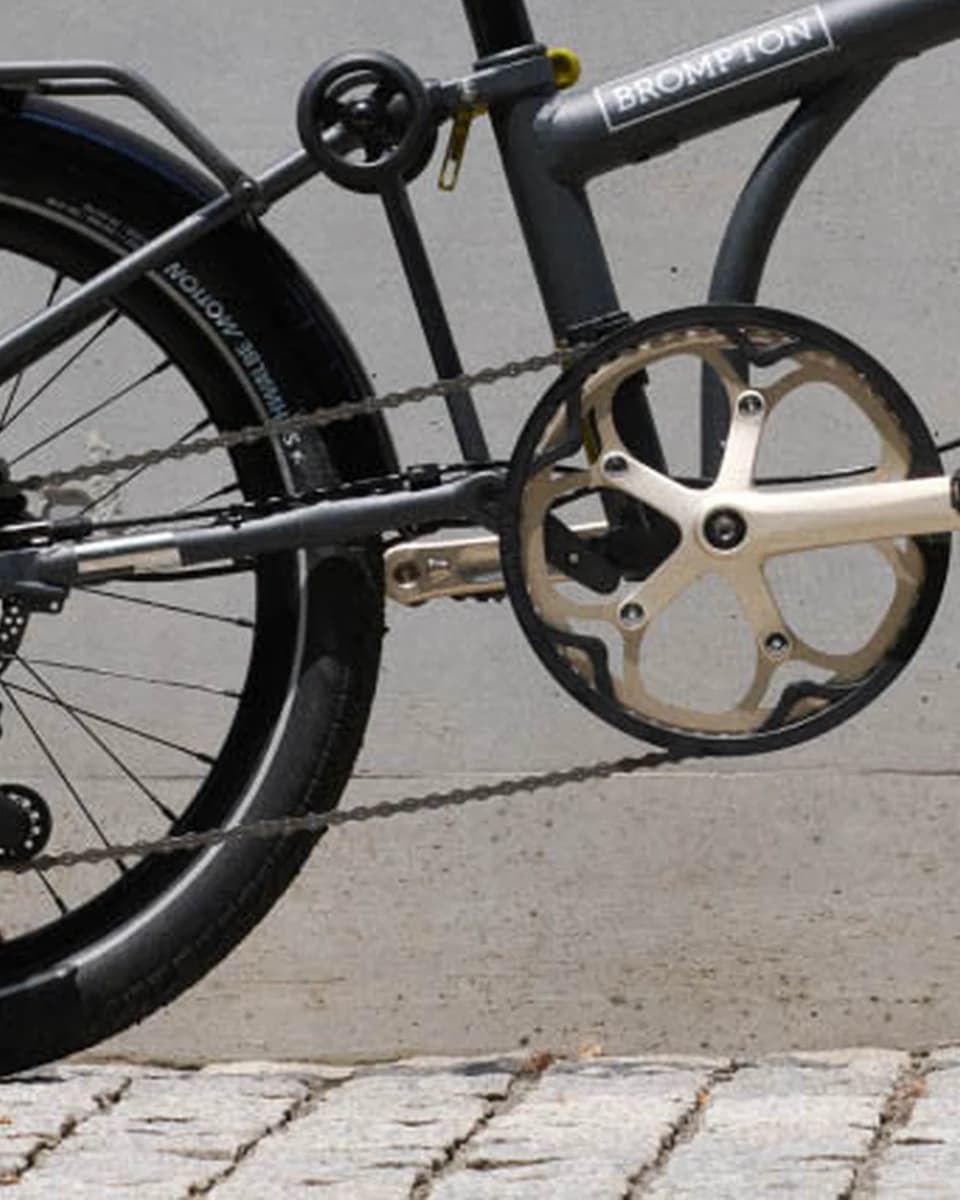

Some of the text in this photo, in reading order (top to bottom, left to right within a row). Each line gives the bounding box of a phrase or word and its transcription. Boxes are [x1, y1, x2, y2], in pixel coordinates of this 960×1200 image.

[613, 16, 813, 112] BROMPTON
[163, 260, 301, 448] SHWALBE MOTION
